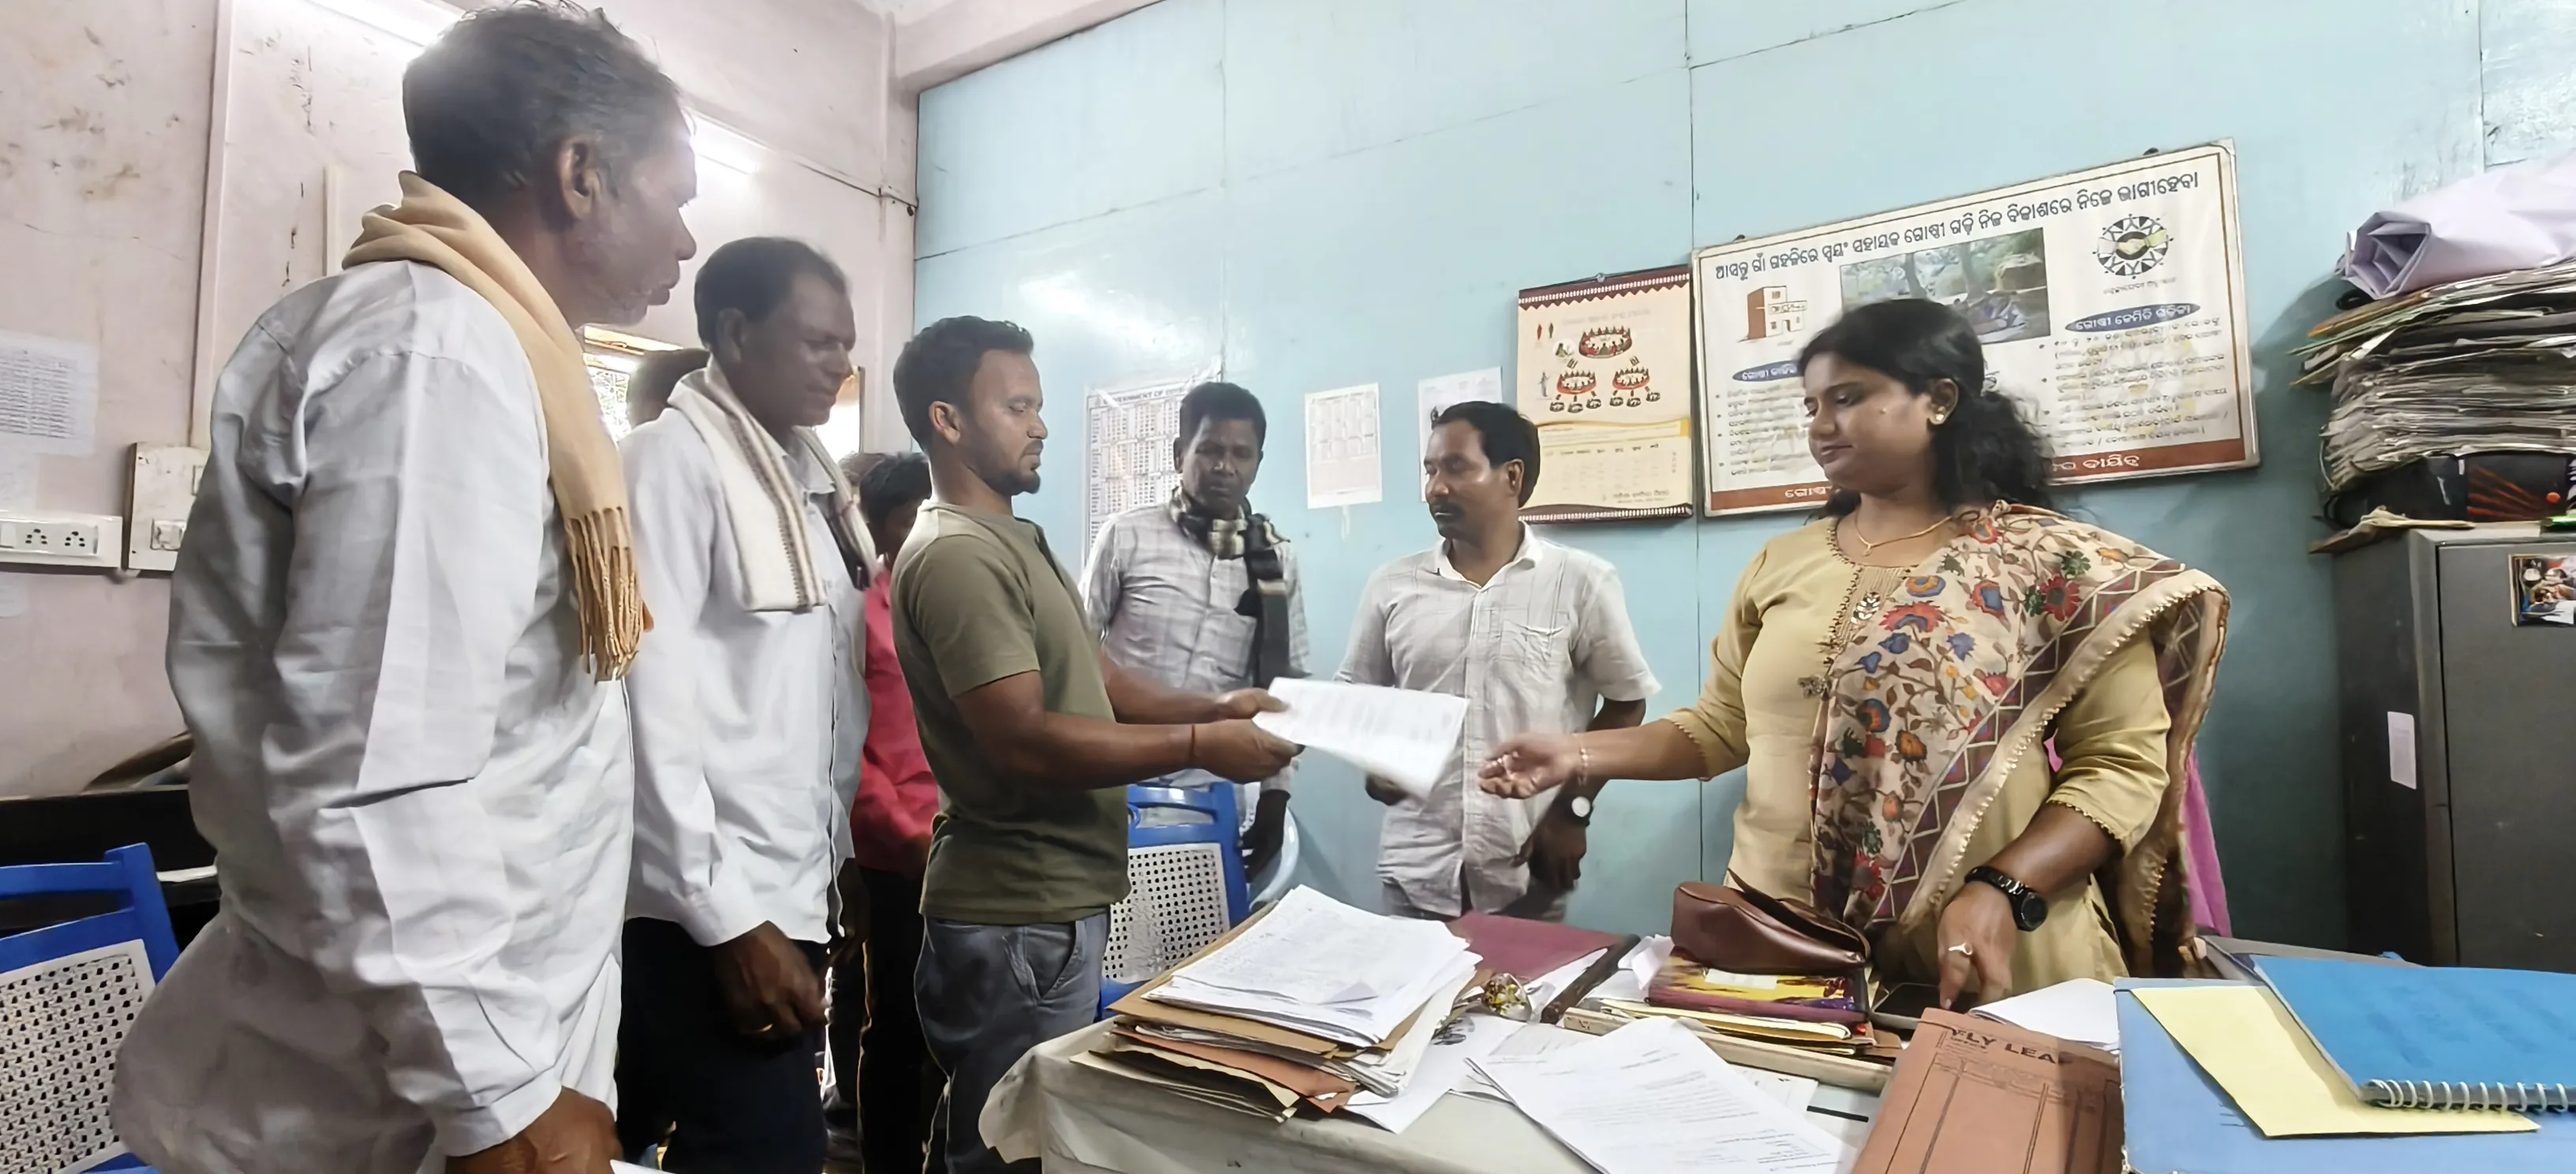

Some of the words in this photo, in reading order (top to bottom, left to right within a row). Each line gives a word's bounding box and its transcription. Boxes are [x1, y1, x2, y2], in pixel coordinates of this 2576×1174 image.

[1852, 231, 1900, 253] ସହାୟକ
[1978, 209, 2002, 230] ନିଜ
[2007, 197, 2072, 222] ବିକାଶରେ
[2076, 189, 2113, 210] ନିଜେ
